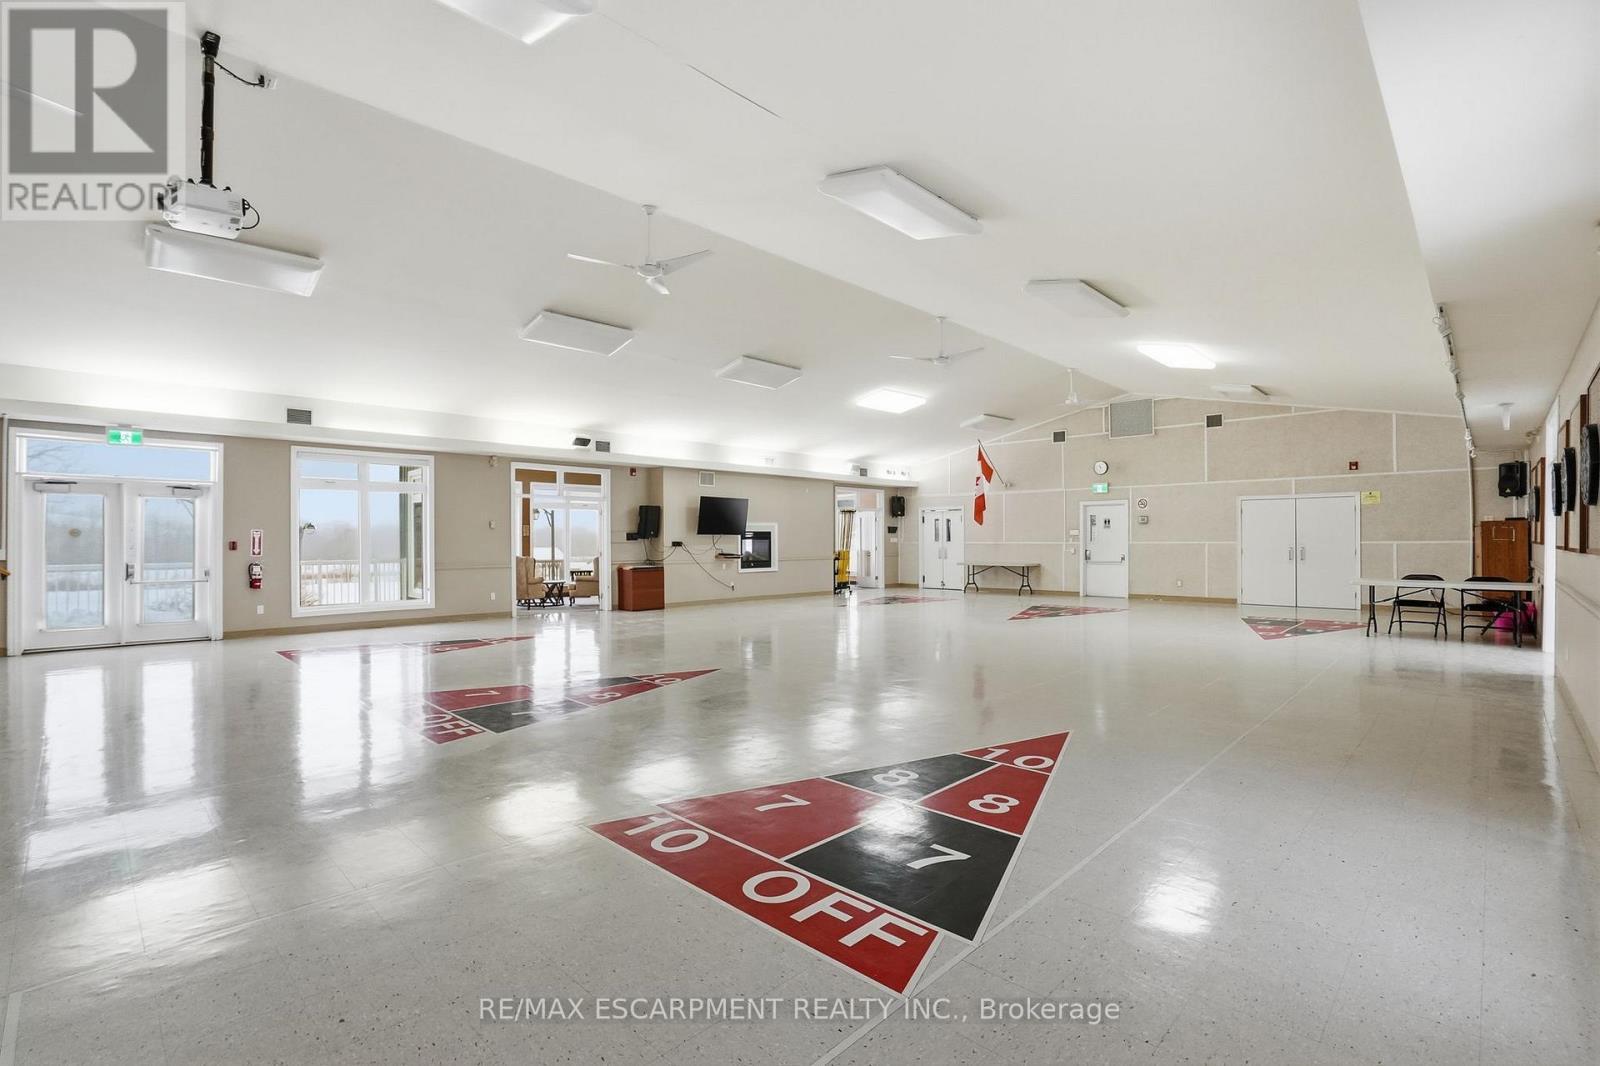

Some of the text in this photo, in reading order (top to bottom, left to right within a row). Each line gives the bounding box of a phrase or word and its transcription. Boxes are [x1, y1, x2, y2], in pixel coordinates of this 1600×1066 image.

[980, 747, 1055, 770] 10
[872, 769, 919, 786] 8
[755, 794, 811, 812] 7
[968, 793, 1020, 815] 8
[907, 843, 972, 870] 7
[624, 814, 929, 947] 10 OFF
